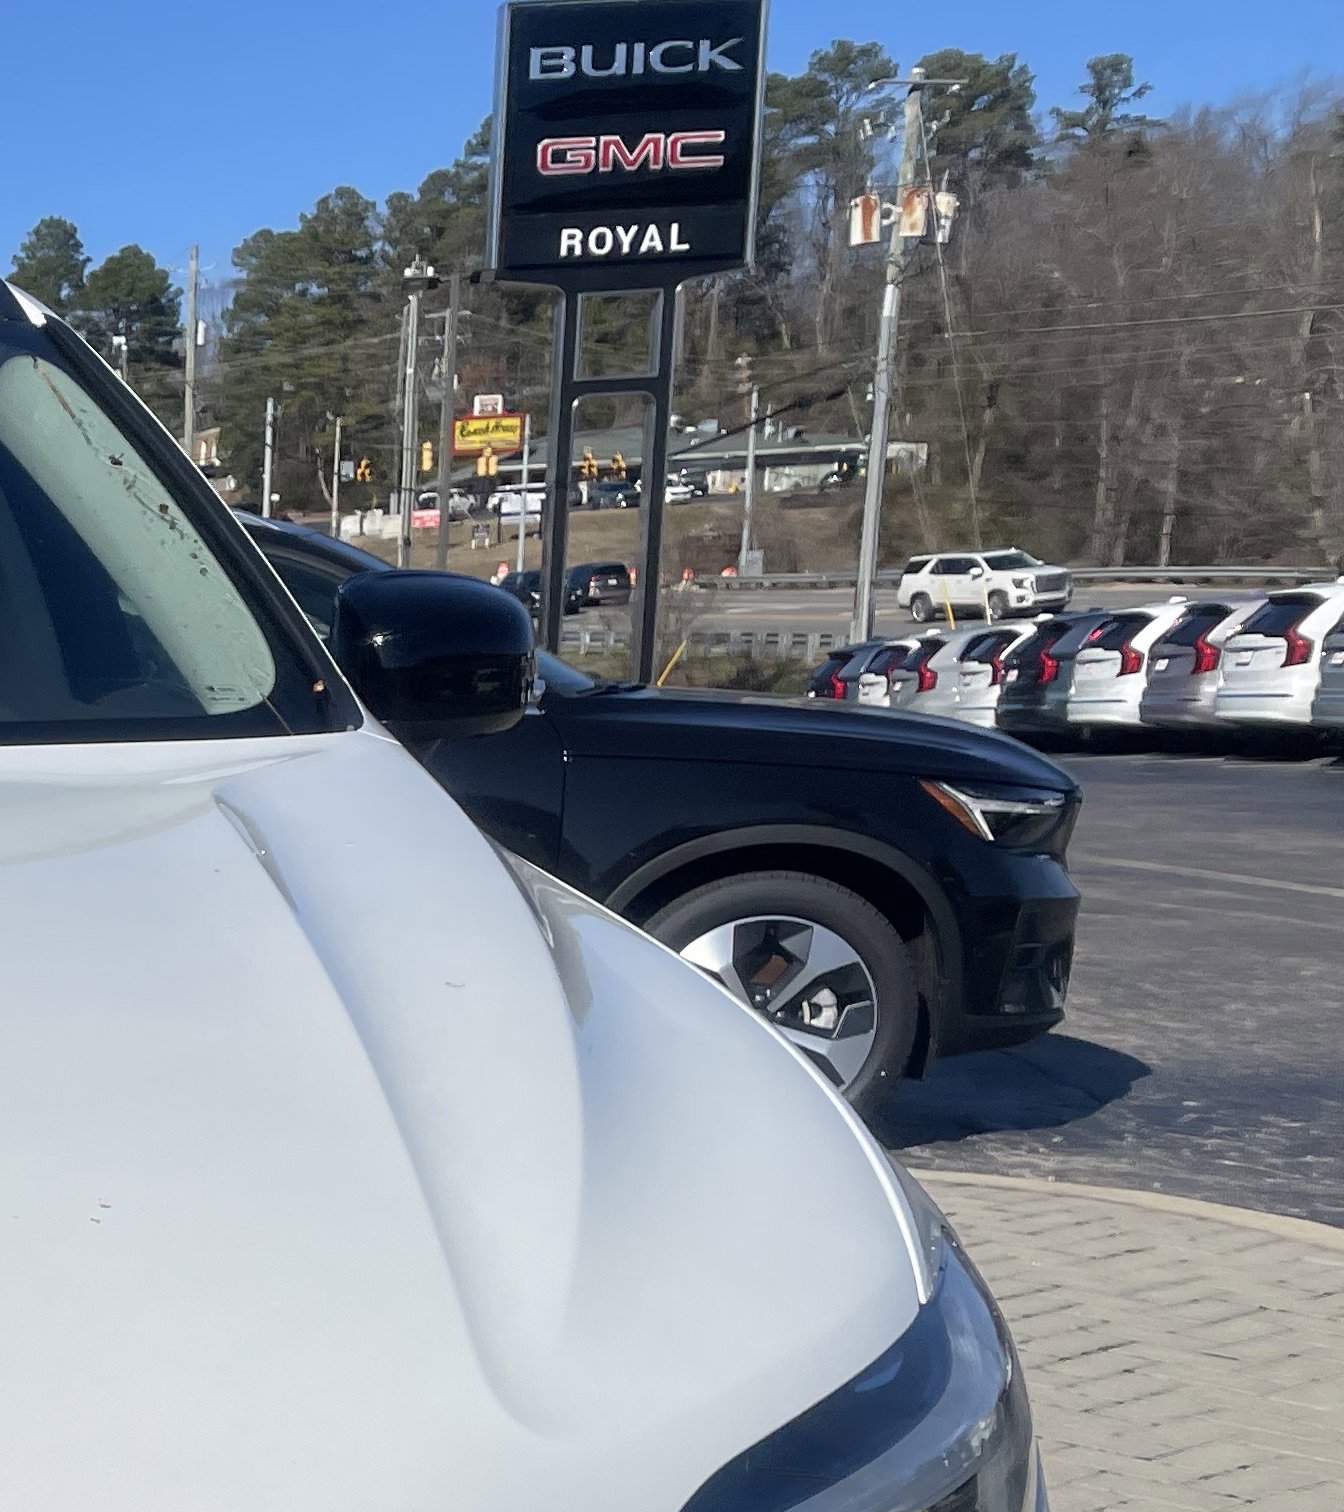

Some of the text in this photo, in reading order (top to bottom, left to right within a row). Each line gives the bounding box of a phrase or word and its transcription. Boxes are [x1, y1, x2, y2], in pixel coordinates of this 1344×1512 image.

[528, 37, 745, 81] BUICK
[536, 129, 725, 176] GMC
[559, 222, 691, 258] ROYAL
